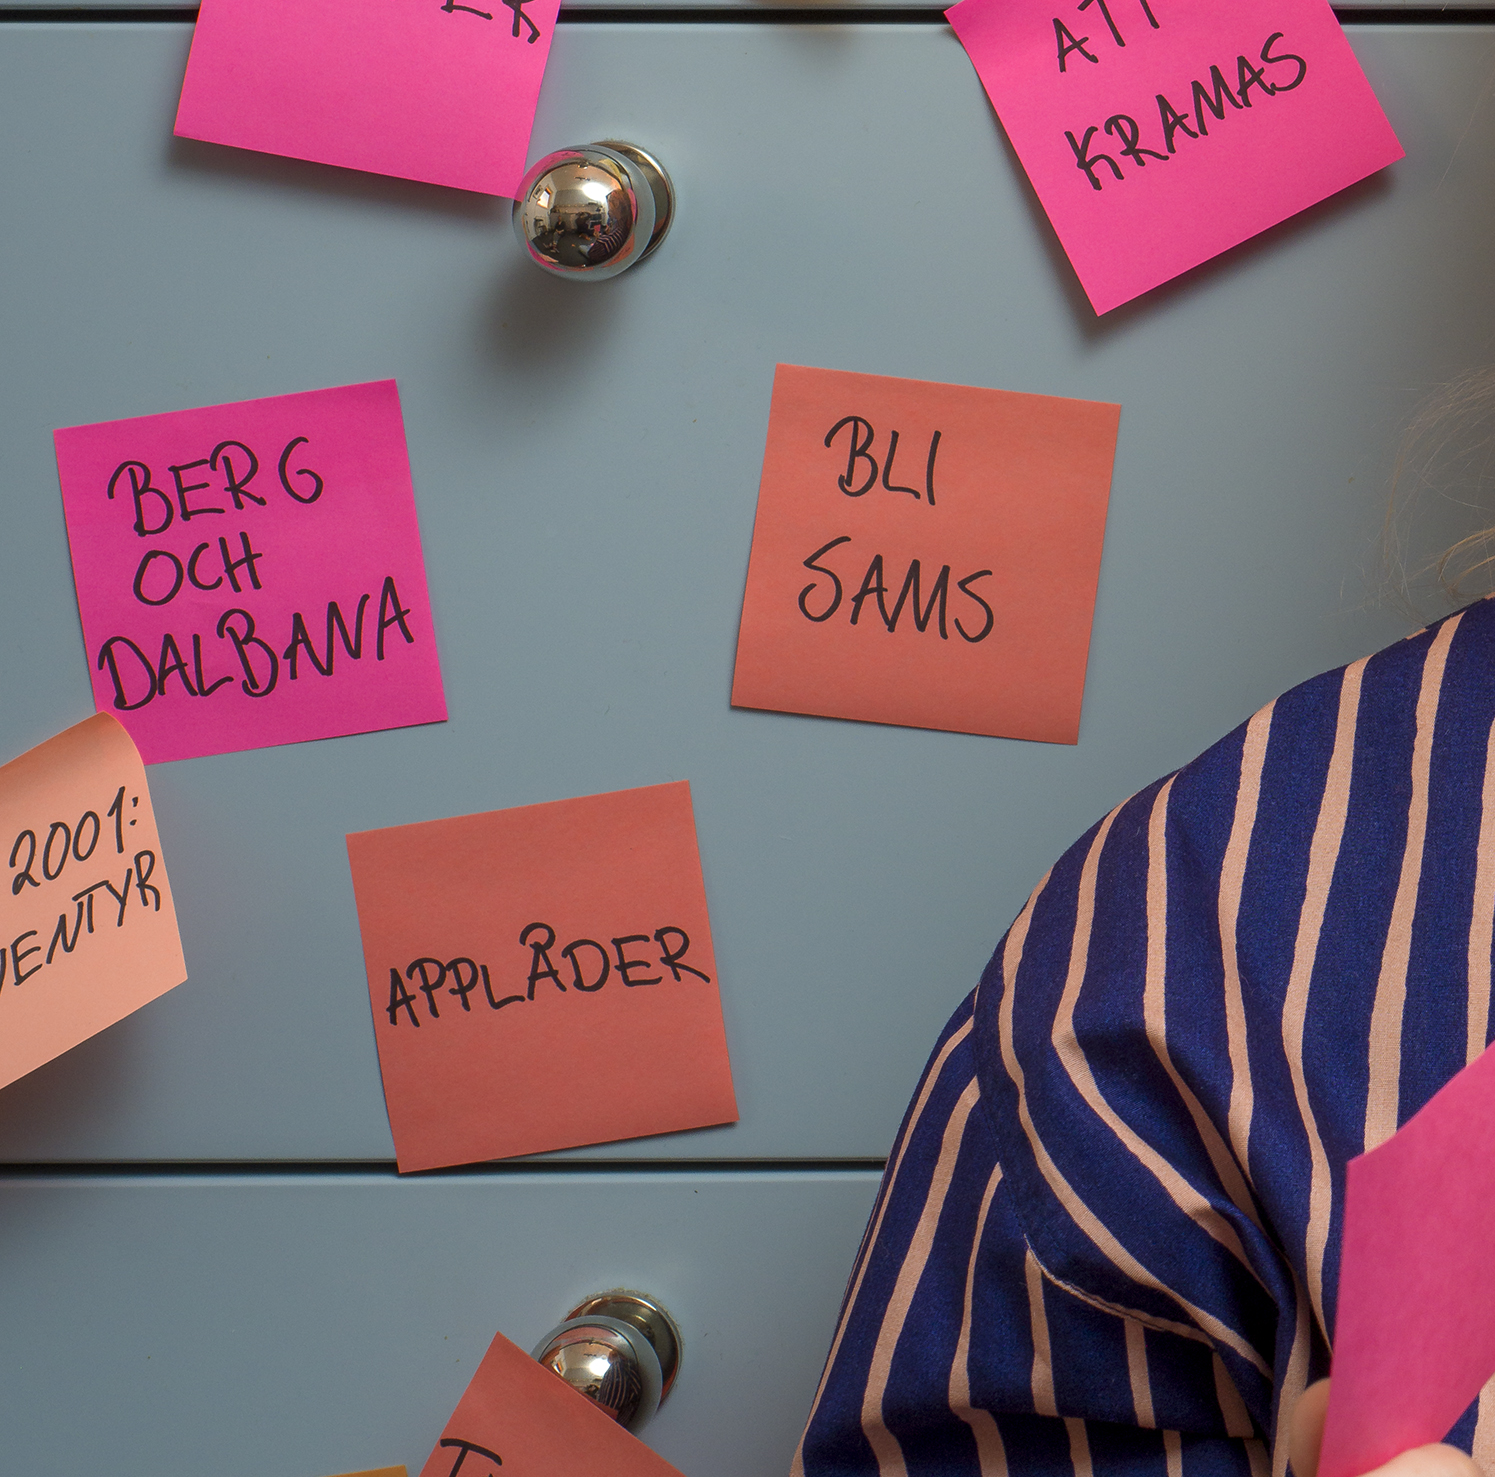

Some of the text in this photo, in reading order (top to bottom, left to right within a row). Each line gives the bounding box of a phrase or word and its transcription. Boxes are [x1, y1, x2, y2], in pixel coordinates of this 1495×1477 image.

[1064, 32, 1306, 191] KRAMAS
[107, 437, 323, 537] BERG
[824, 416, 941, 506] BLI
[133, 532, 262, 606] OCH
[798, 536, 994, 643] SAMS
[98, 576, 414, 711] DALBANA
[9, 785, 139, 896] 2001:
[386, 922, 710, 1027] APPLÅDER
